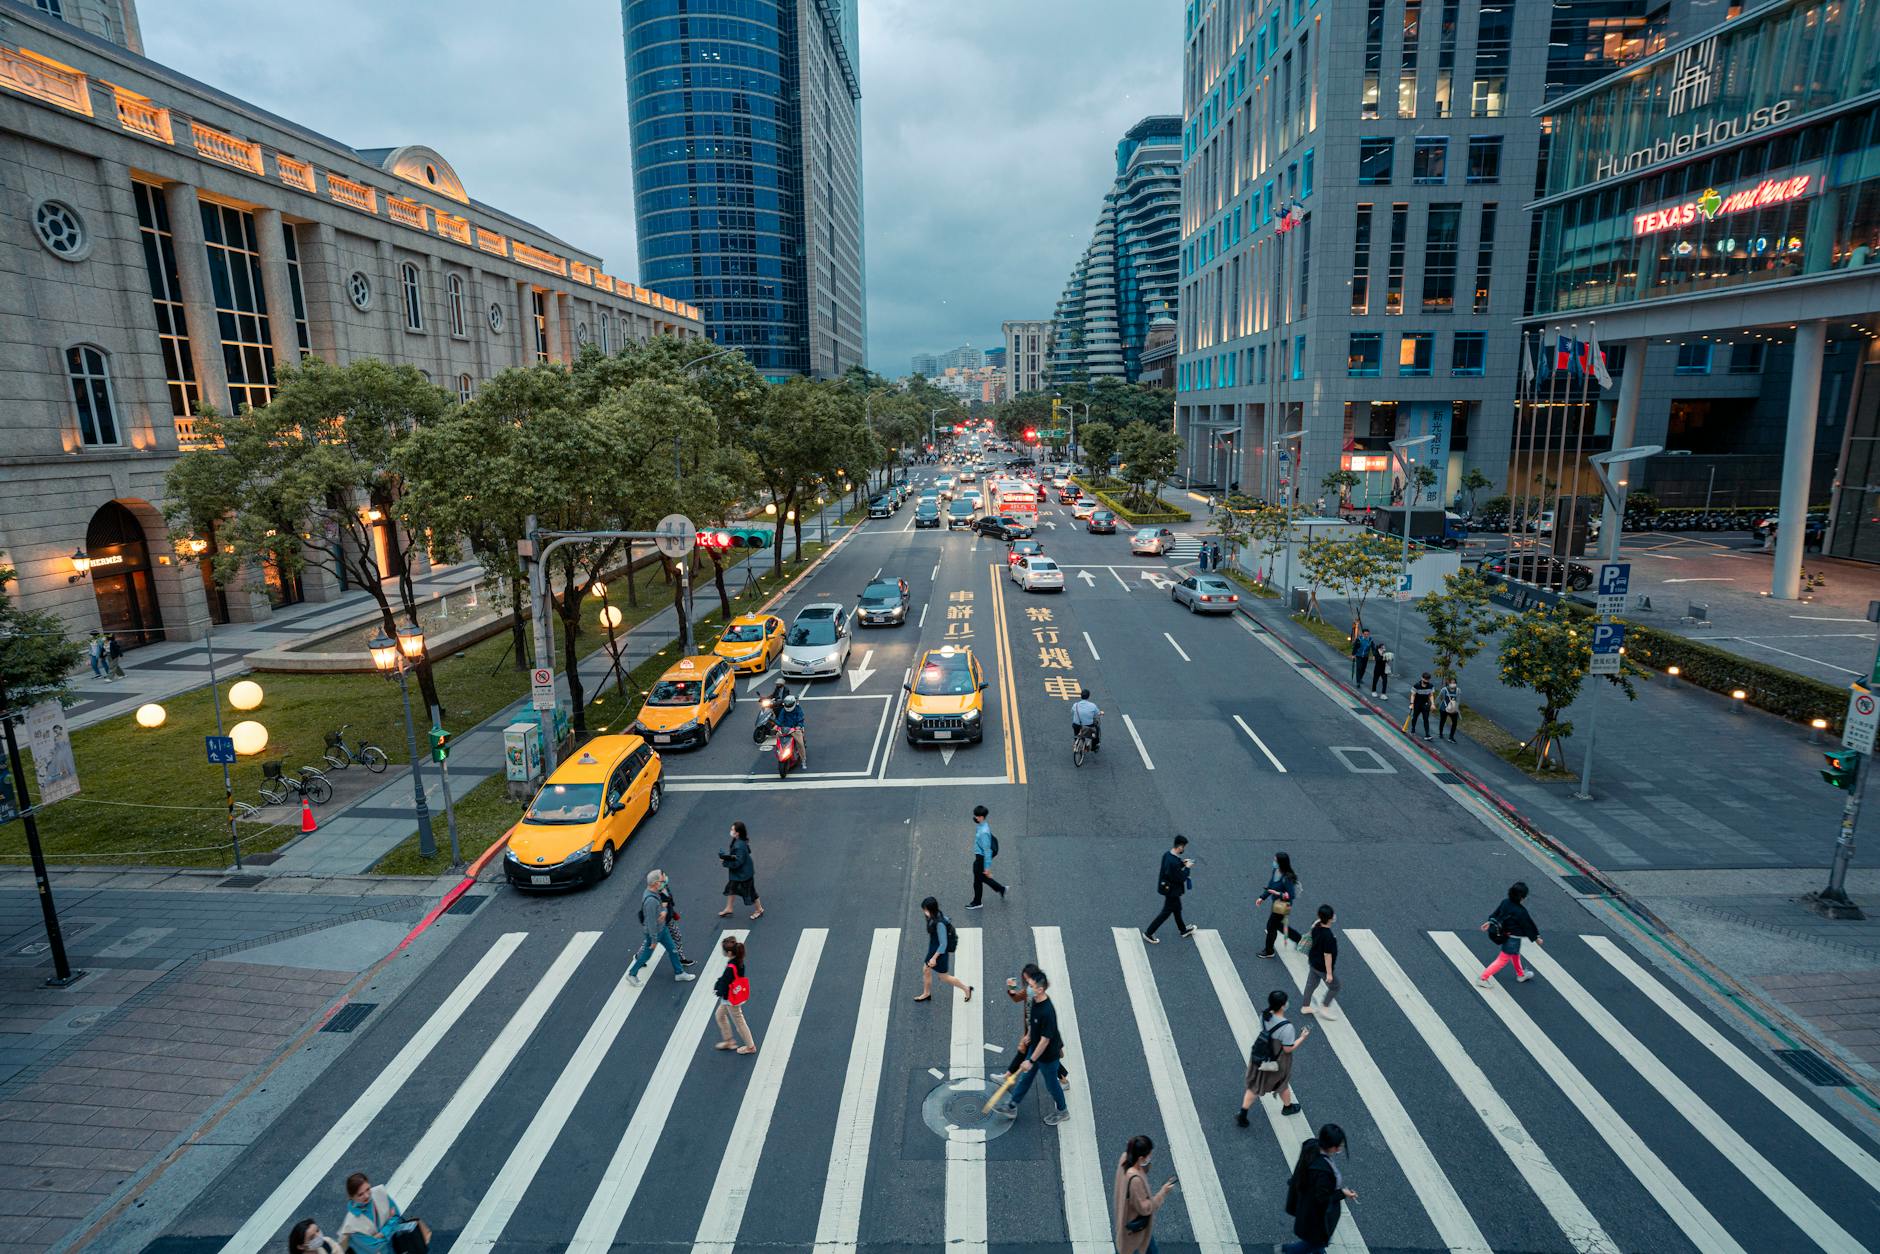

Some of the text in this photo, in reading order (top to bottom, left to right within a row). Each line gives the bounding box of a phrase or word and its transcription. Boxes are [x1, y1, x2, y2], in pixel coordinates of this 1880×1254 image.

[1596, 100, 1791, 181] HumbleHouse
[1634, 202, 1697, 235] TEXAS
[1397, 576, 1408, 590] P
[1603, 567, 1620, 586] P
[1595, 626, 1613, 644] P
[1025, 607, 1083, 700] 禁行機車
